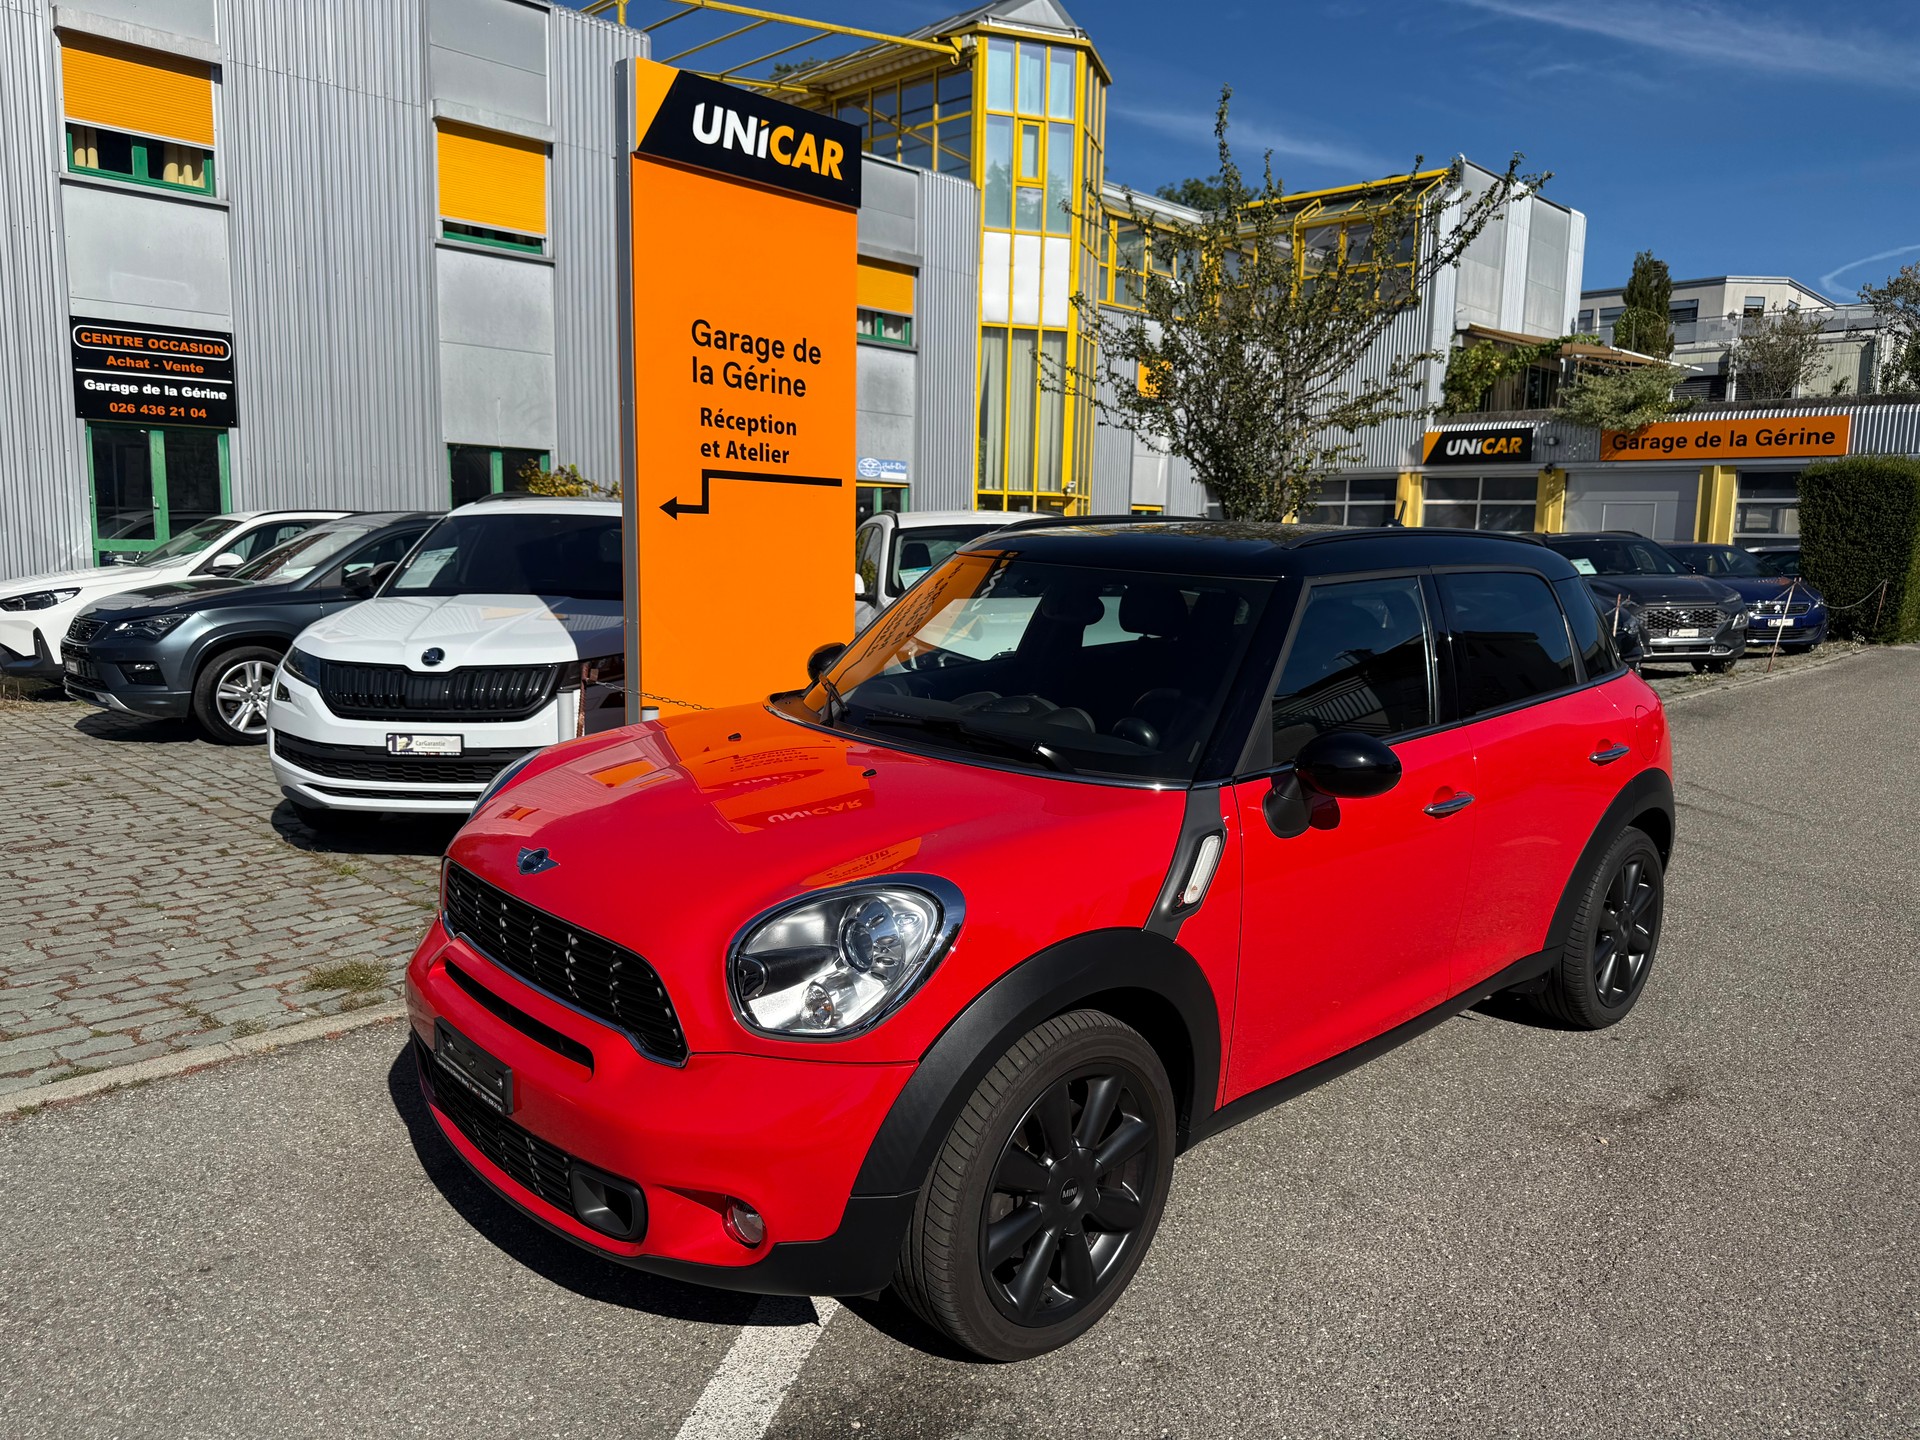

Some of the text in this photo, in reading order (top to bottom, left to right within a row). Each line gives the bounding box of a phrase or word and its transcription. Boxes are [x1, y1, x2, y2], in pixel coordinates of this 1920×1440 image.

[80, 332, 225, 356] CENTRE OCCASION
[691, 319, 822, 365] Garage de
[106, 355, 150, 369] Achat
[162, 359, 205, 374] Vente
[691, 356, 807, 398] la Gérine
[83, 379, 228, 400] Garage de la Gérine
[109, 402, 207, 419] 026 436 21 04
[700, 407, 798, 437] Réception
[700, 440, 790, 464] et Atelier
[1612, 427, 1836, 453] Garage de la Gérine
[1062, 1186, 1078, 1199] MINI
